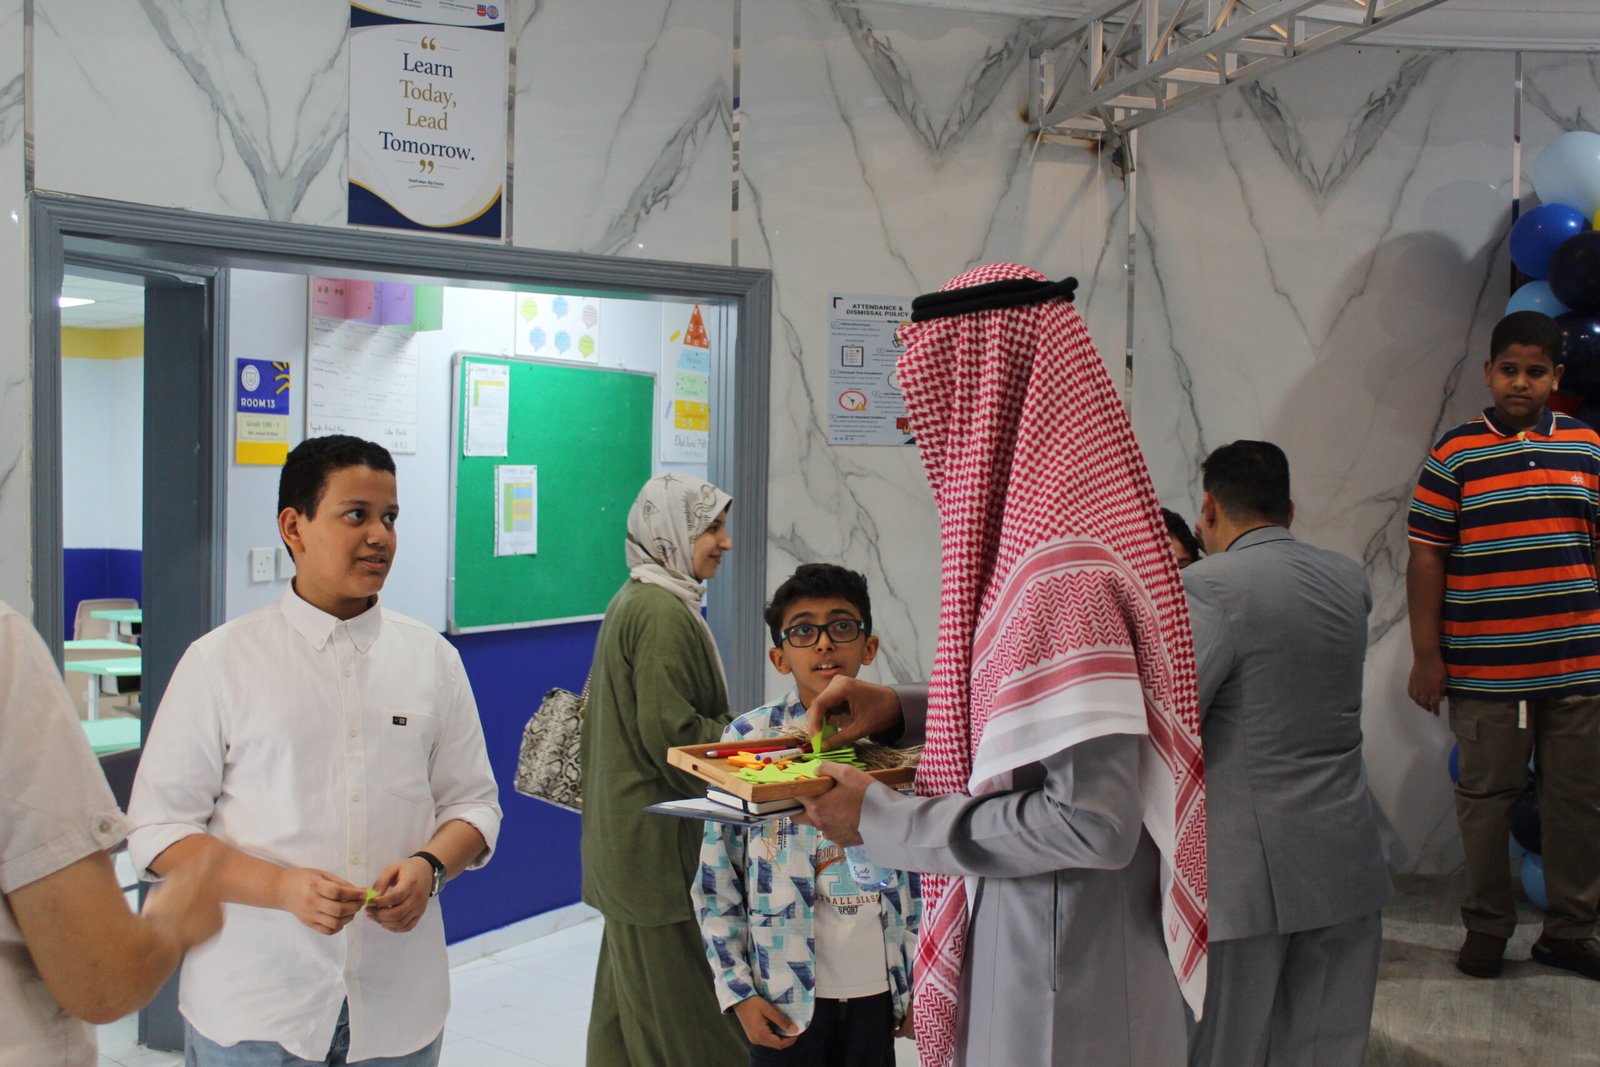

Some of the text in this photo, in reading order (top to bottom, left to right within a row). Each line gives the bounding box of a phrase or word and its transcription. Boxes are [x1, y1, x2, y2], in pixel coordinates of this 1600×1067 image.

[402, 52, 454, 78] Learn
[399, 79, 457, 109] Today,
[406, 106, 448, 131] Lead
[378, 130, 475, 161] Tomorrow.
[846, 309, 910, 318] DISMISSAL POLICY
[852, 303, 897, 311] ATTENDANCE
[240, 397, 276, 408] ROOM 13
